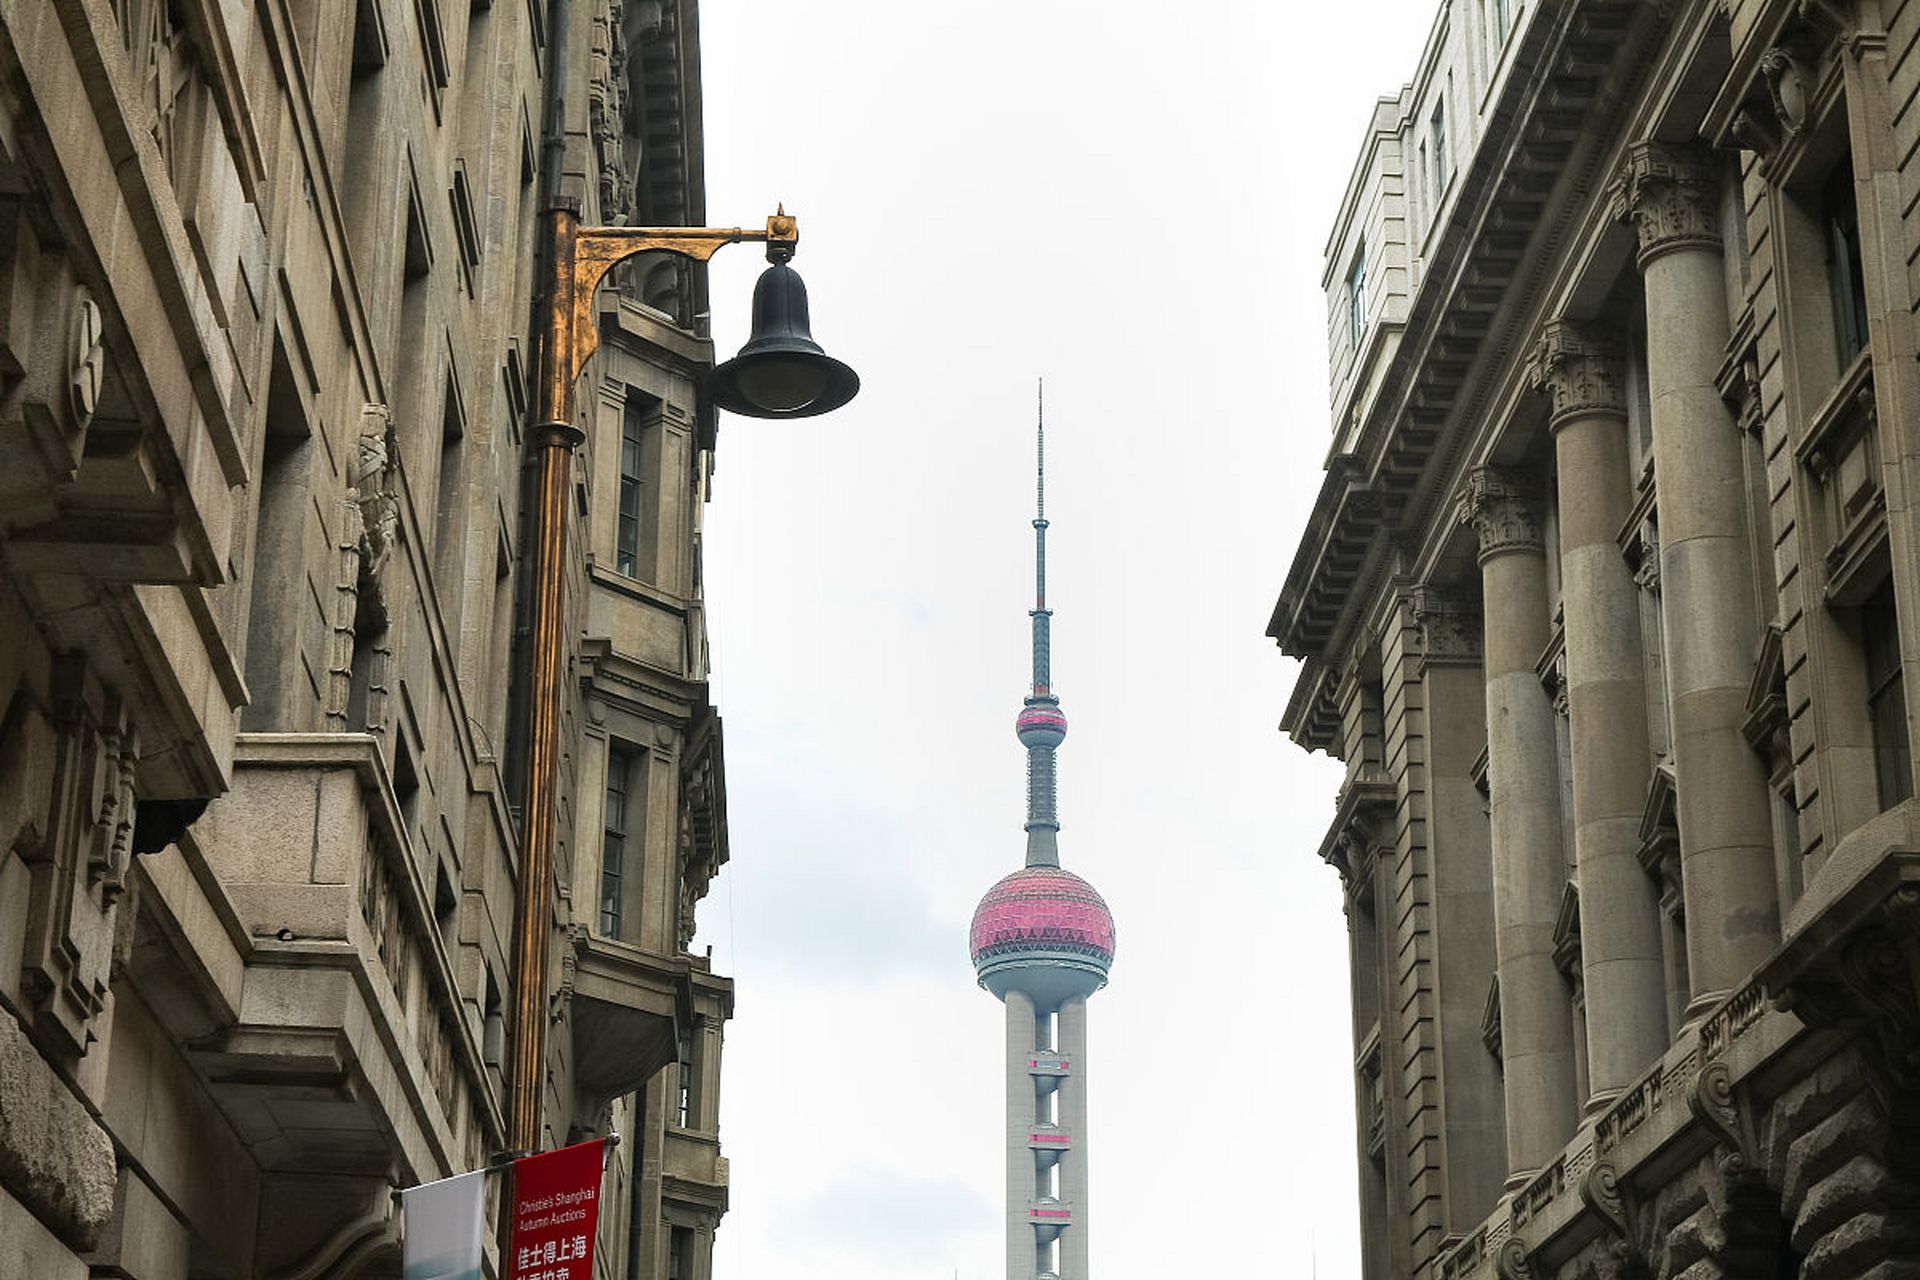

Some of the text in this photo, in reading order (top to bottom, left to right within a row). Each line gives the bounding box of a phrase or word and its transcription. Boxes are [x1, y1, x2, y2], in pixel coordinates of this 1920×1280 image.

[520, 1186, 595, 1215] Christie's Shanghai
[520, 1209, 586, 1231] Autumn Auctions
[518, 1235, 587, 1270] 佳士得上海
